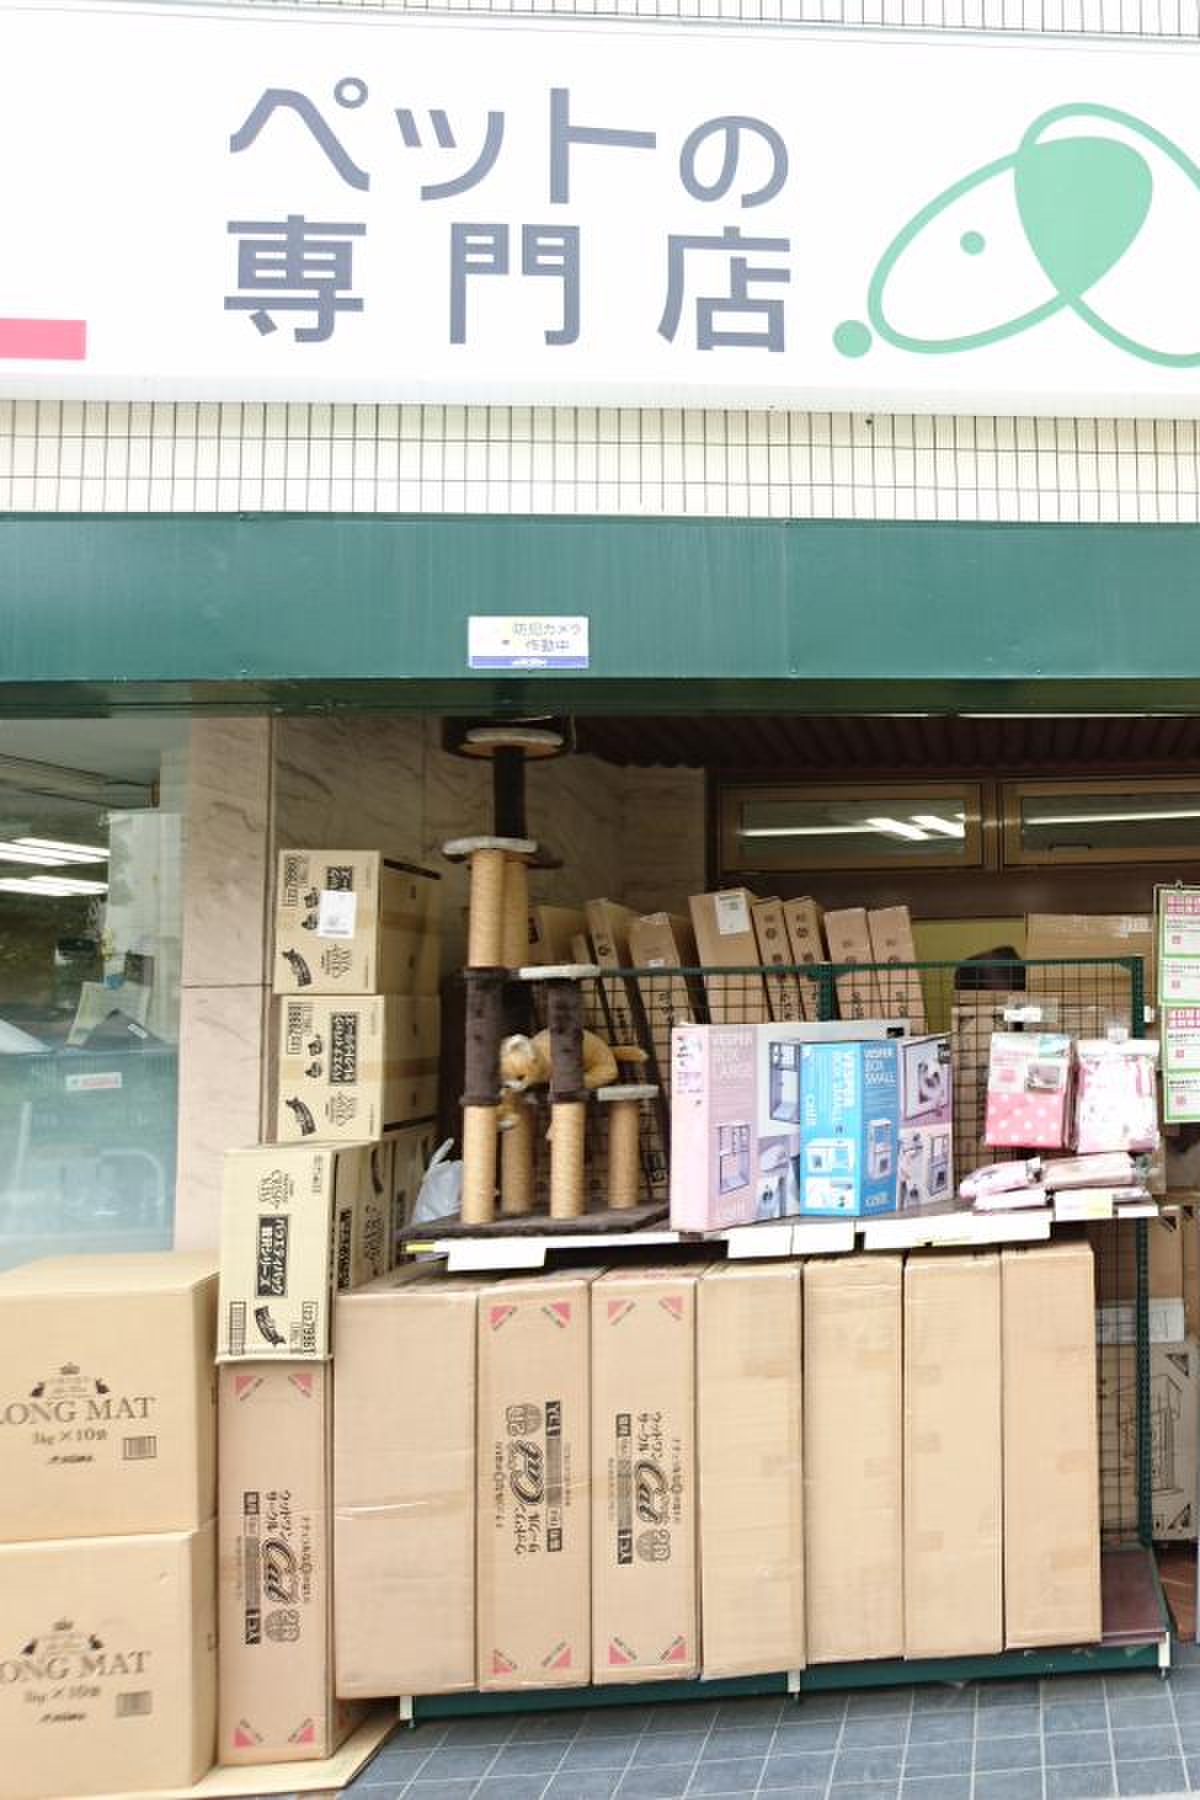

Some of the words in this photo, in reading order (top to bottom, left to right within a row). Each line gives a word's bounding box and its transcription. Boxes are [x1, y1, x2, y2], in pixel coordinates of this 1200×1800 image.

[229, 76, 789, 209] ペットの
[224, 214, 791, 353] 専門店
[0, 1399, 77, 1425] ONG
[86, 1396, 156, 1421] MAT
[81, 1650, 152, 1679] MAT
